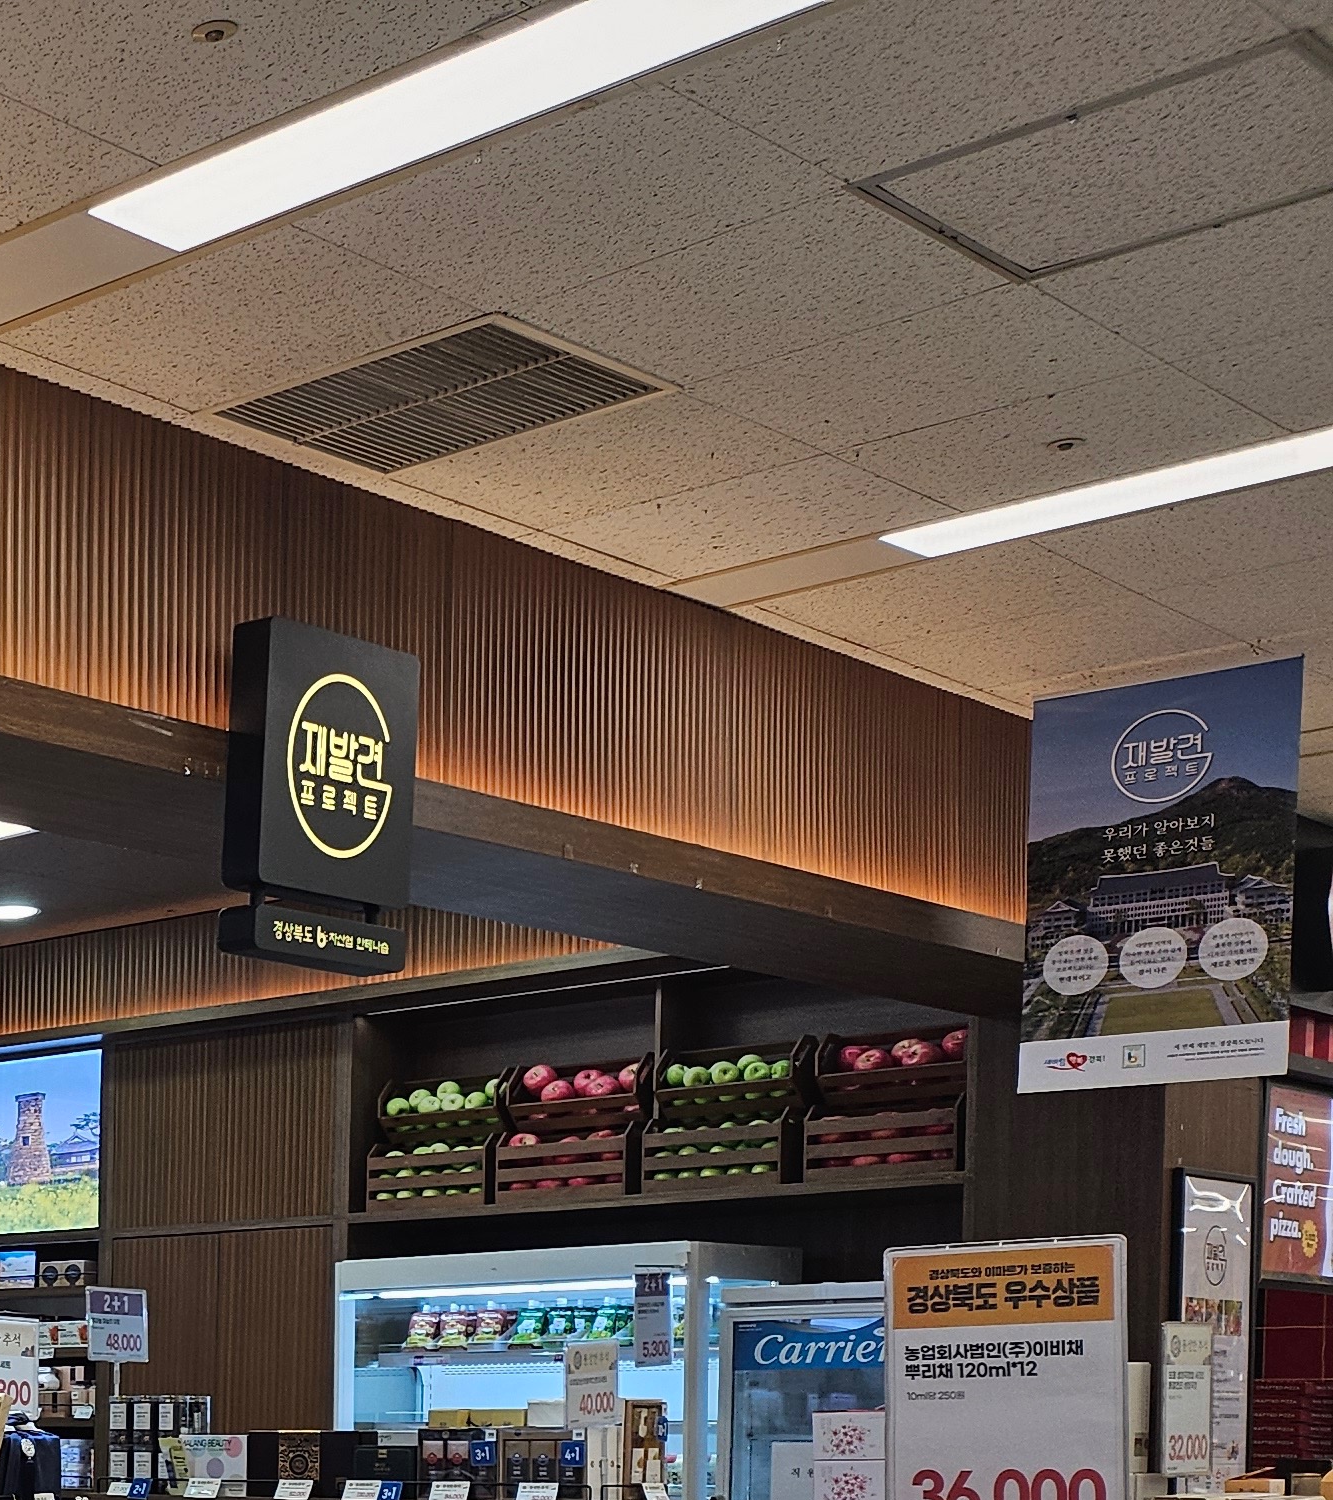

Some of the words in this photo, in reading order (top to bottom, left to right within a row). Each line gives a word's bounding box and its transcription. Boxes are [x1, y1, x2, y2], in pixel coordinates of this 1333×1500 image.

[299, 721, 392, 791] 재발견
[1122, 732, 1211, 768] 재발견
[1123, 762, 1200, 785] 프로젝트
[300, 780, 377, 820] 프로젝트
[1102, 823, 1148, 842] 우리가
[1153, 813, 1216, 836] 알아보지
[1101, 844, 1147, 864] 못했던
[1153, 836, 1216, 858] 좋은것들
[273, 920, 314, 943] 경상북도
[355, 937, 390, 955] 안테나숍
[1274, 1107, 1307, 1137] Fresh
[1273, 1141, 1315, 1175] dough.
[1272, 1178, 1318, 1209] Crafted
[1270, 1210, 1302, 1242] pizza.
[928, 1267, 982, 1281] 경상북도와
[984, 1264, 1028, 1279] 이마트가
[103, 1294, 130, 1313] 2+1
[906, 1282, 998, 1315] 경상북도
[1004, 1275, 1100, 1309] 우수상품
[3, 1331, 22, 1347] 추석
[105, 1333, 143, 1352] 48,000
[904, 1338, 1084, 1362] 농업회사법인(주)이비채
[904, 1362, 954, 1380] 뿌리채
[1167, 1433, 1208, 1463] 32,000
